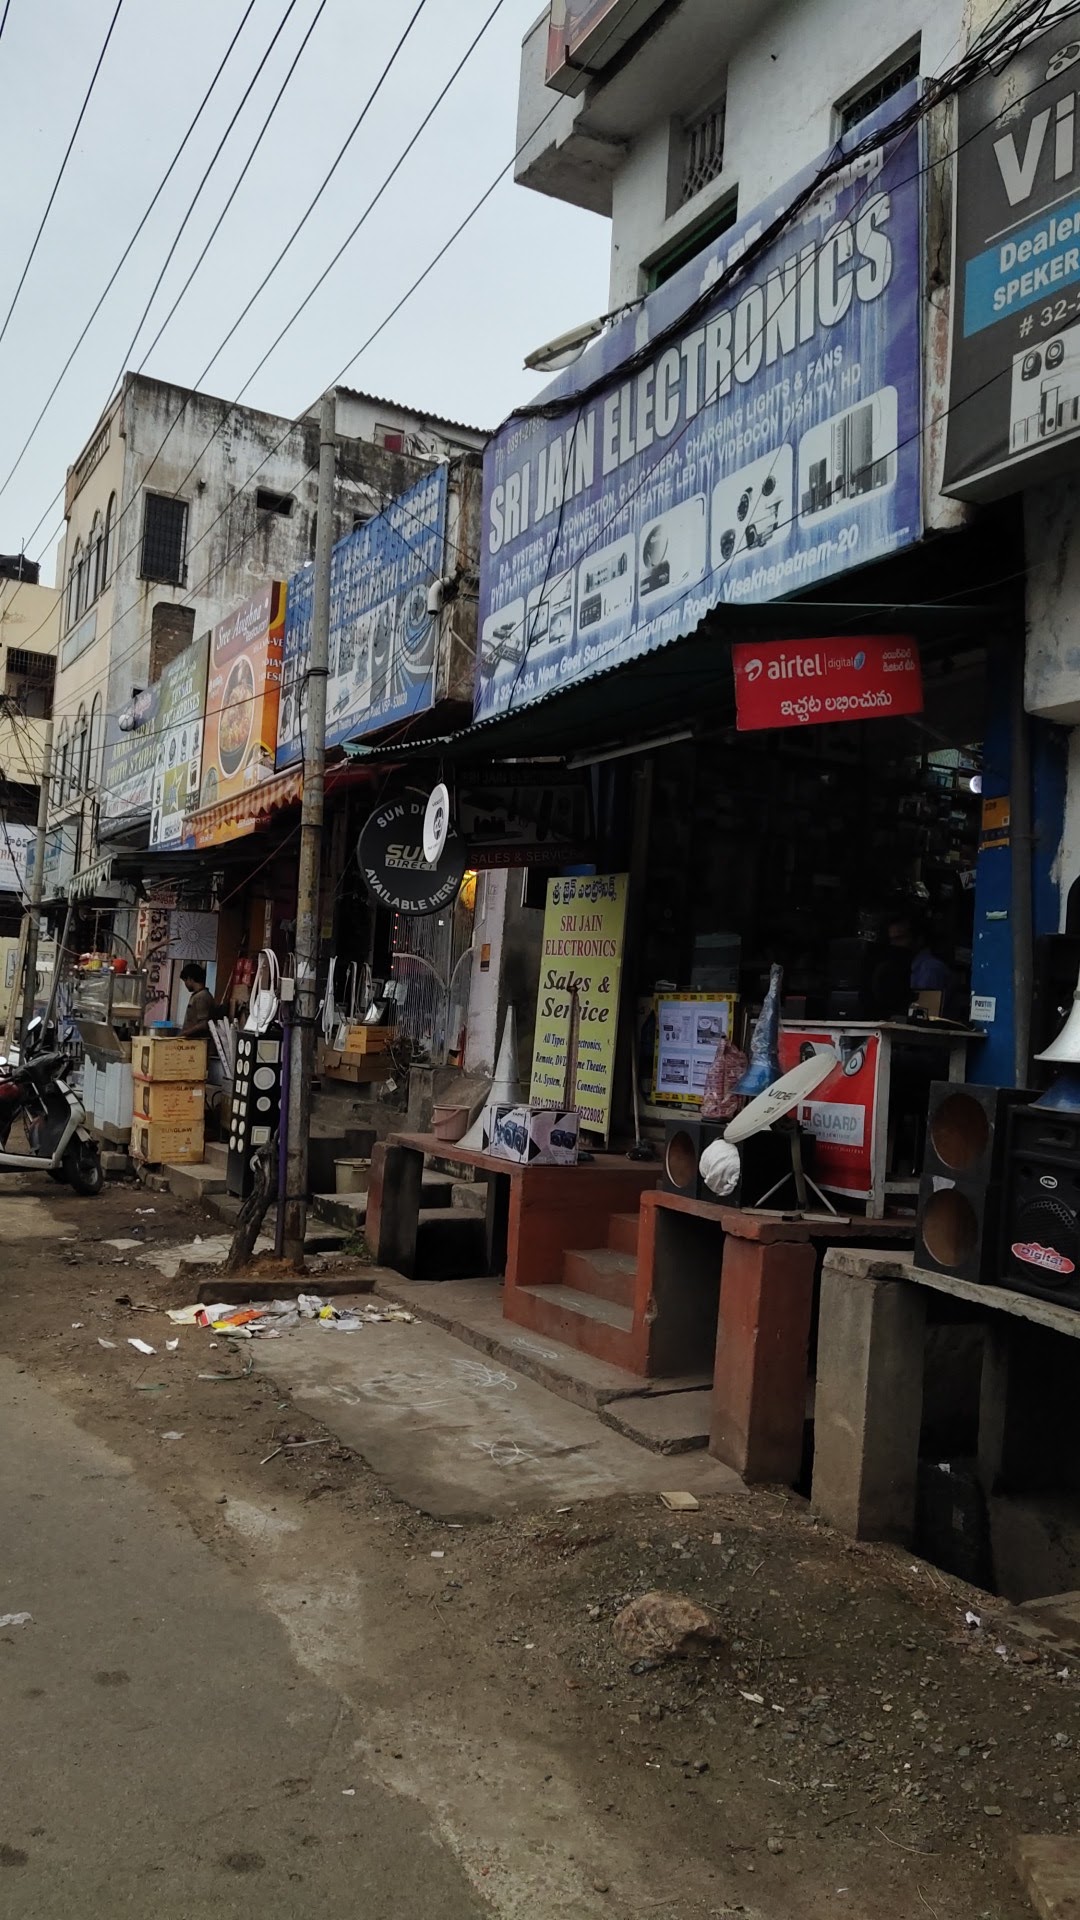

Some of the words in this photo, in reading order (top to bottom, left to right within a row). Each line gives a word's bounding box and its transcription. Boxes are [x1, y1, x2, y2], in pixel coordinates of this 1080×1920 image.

[488, 461, 529, 557] SRI
[534, 409, 595, 523] JAIN
[602, 192, 893, 472] ELECTRONICS
[676, 459, 696, 489] LED
[717, 409, 778, 465] VIDEOCON
[782, 388, 812, 426] DISH
[840, 358, 861, 392] HD
[562, 488, 616, 539] CONNECTION,
[685, 406, 742, 461] CHARGING
[746, 375, 789, 422] LIGHTS
[793, 367, 803, 392] &
[807, 342, 842, 385] FANS
[768, 653, 823, 680] airtel
[828, 656, 854, 670] digital
[781, 694, 822, 722] ఇచ్చట
[825, 690, 893, 714] లభించును
[376, 804, 405, 828] SUN
[470, 852, 511, 865] SALES
[513, 851, 523, 862] &
[365, 868, 428, 911] AVAILABLE
[429, 875, 458, 906] HERE
[561, 915, 577, 931] SRI
[579, 915, 603, 931] JAIN
[545, 940, 616, 957] ELECTRONICS
[543, 970, 591, 994] Sales
[597, 978, 611, 994] &
[552, 1033, 565, 1048] Types
[535, 1051, 554, 1066] Remote,
[586, 1059, 607, 1074] Theater,
[543, 1073, 561, 1088] System,
[577, 1079, 606, 1095] Connection
[813, 1113, 858, 1131] GUARD
[1020, 1246, 1064, 1266] Digital
